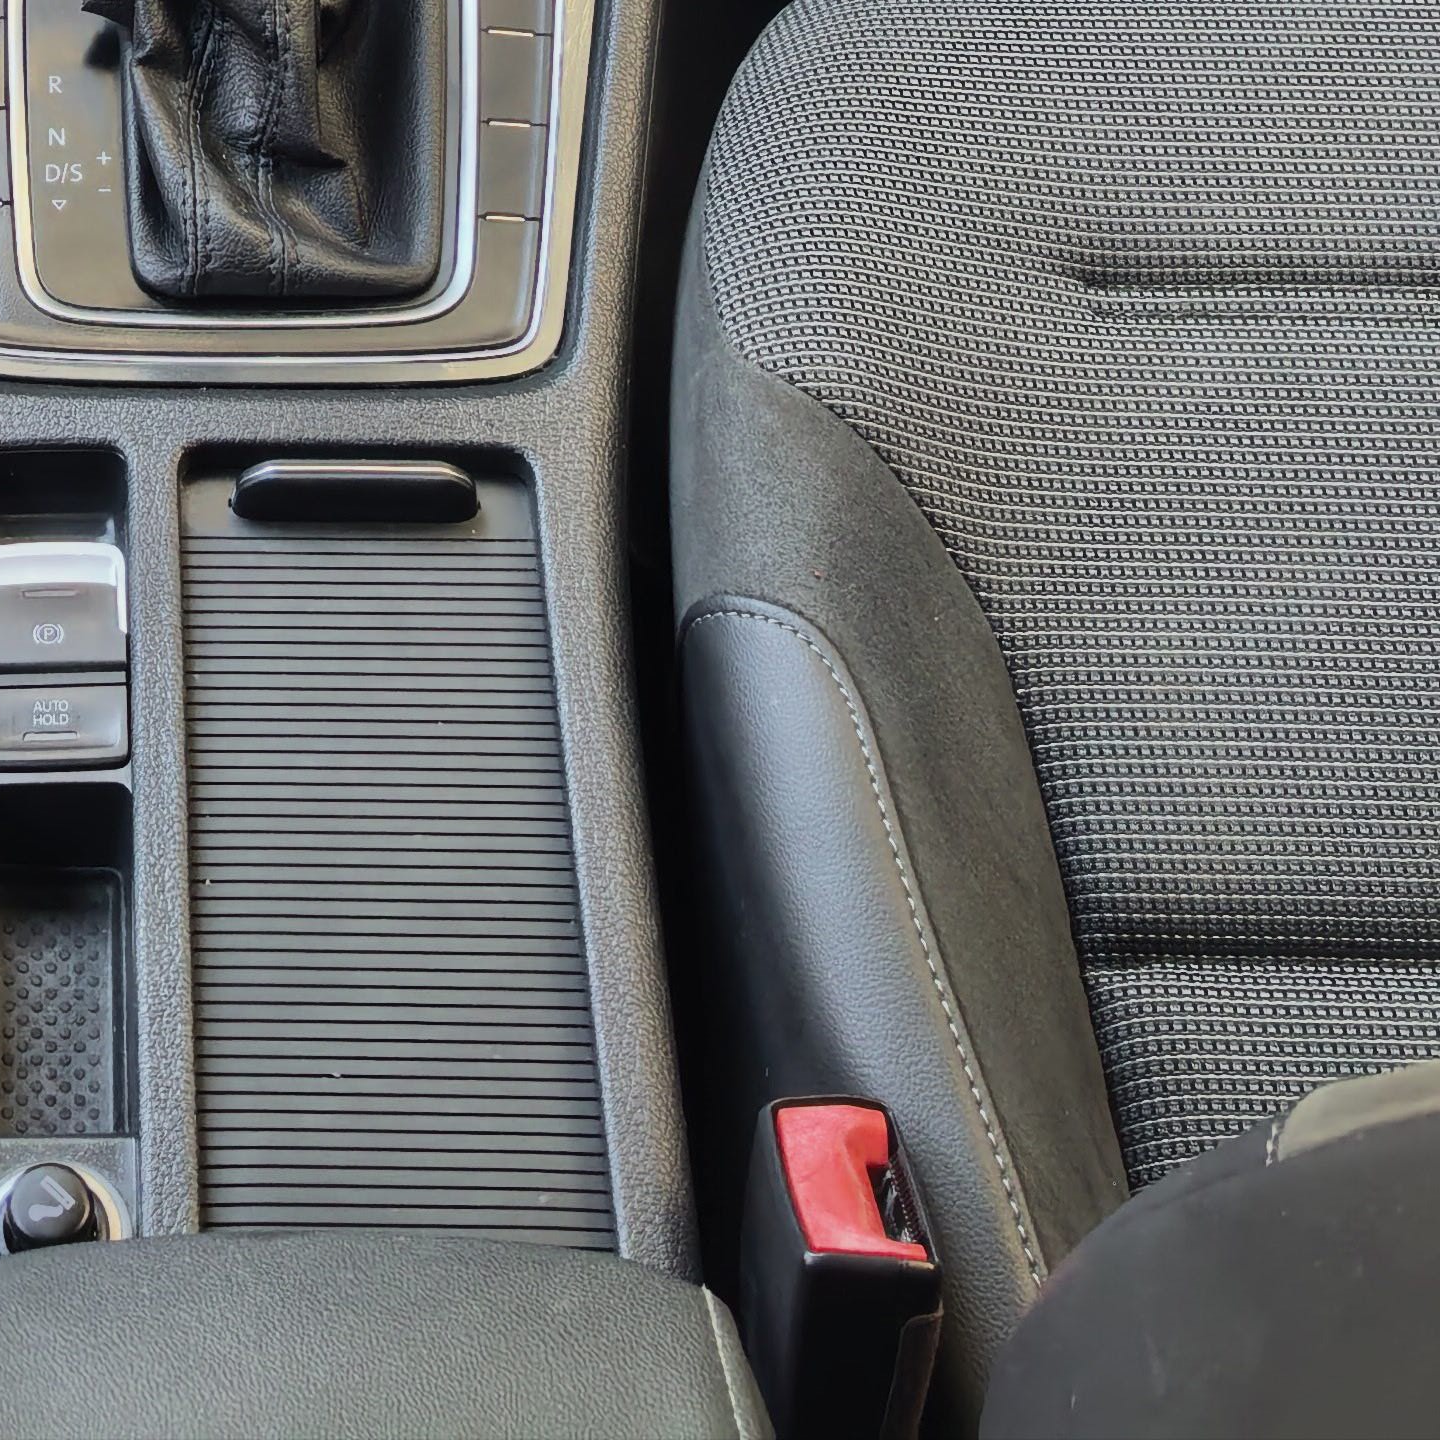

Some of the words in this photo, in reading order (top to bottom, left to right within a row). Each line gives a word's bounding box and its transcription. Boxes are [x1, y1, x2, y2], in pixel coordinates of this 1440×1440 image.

[48, 75, 63, 94] R
[48, 127, 66, 147] N
[45, 163, 84, 183] D/S
[33, 699, 69, 714] AUTO
[32, 713, 69, 726] HOLD
